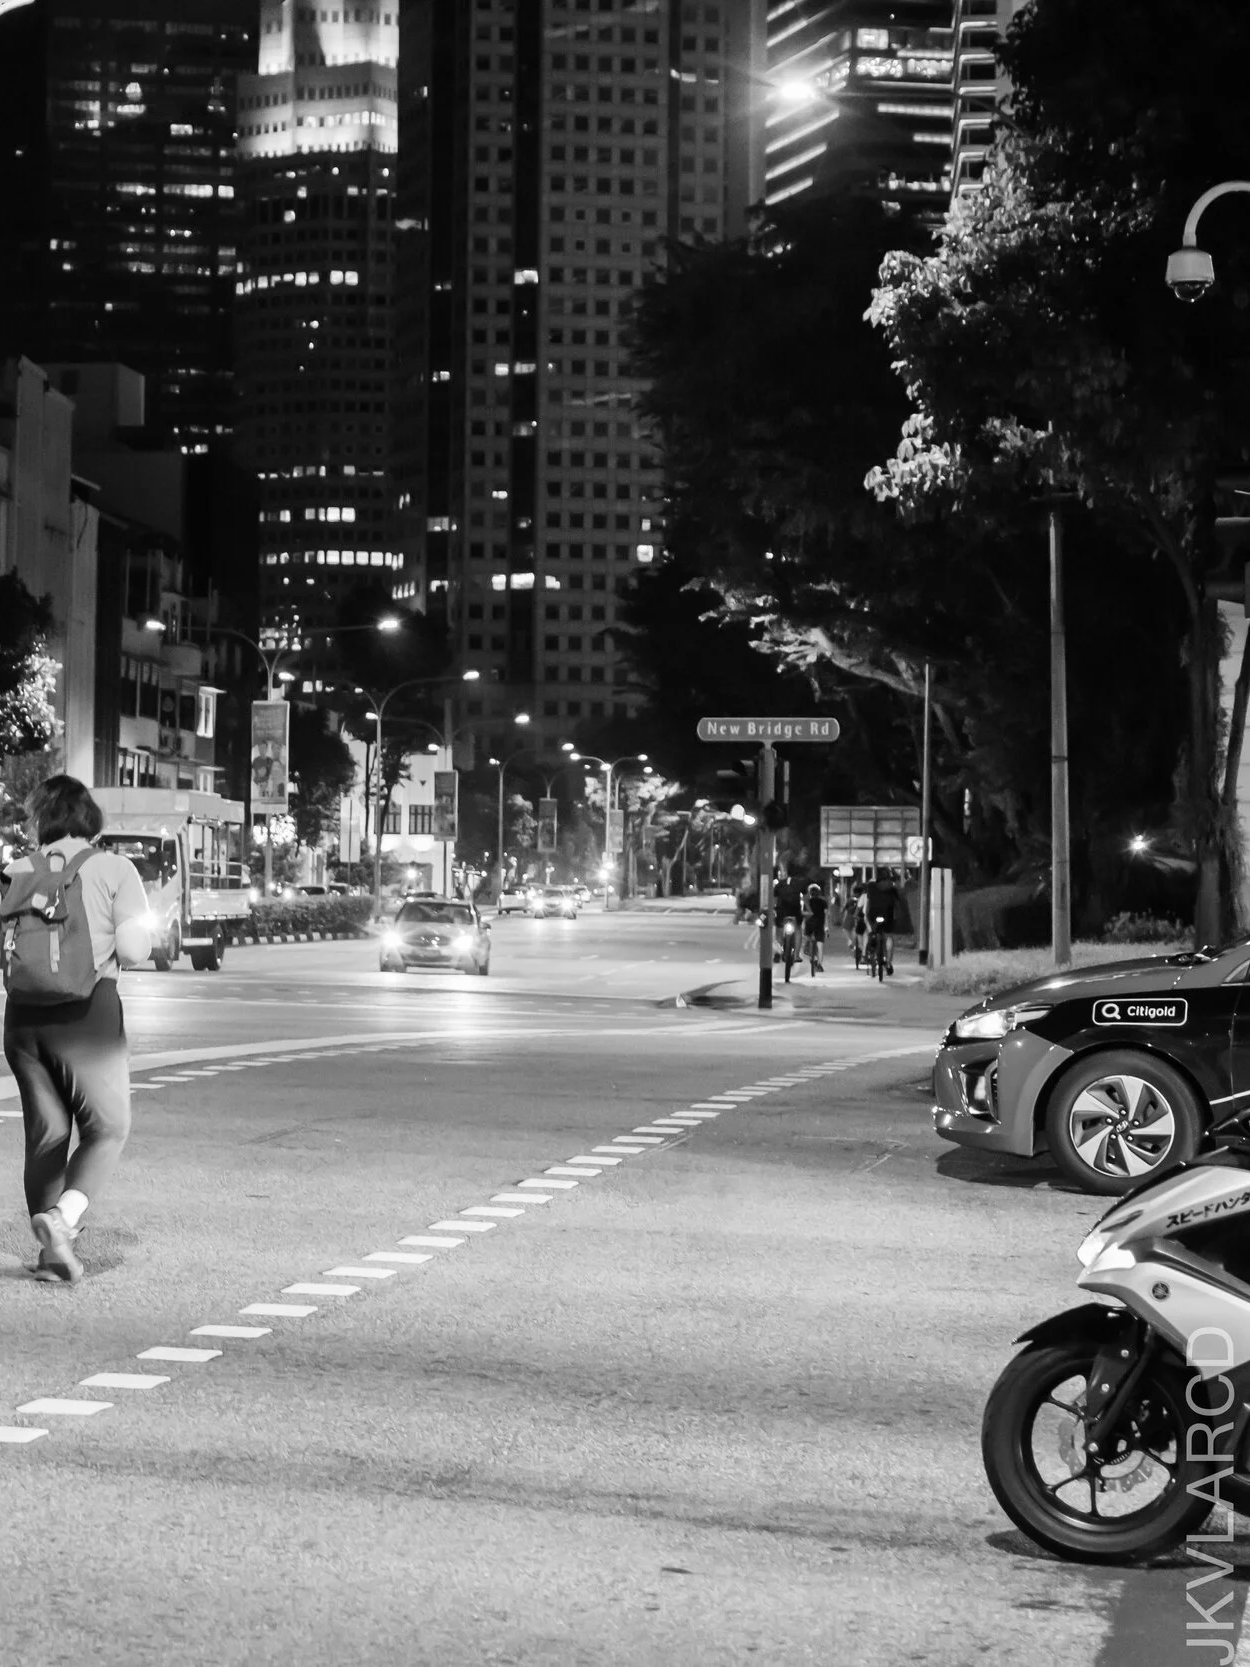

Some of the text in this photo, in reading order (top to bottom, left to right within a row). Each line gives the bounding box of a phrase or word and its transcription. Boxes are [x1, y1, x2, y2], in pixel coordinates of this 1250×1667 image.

[707, 721, 829, 738] New Bridge Rd
[1127, 1006, 1176, 1019] Citigold
